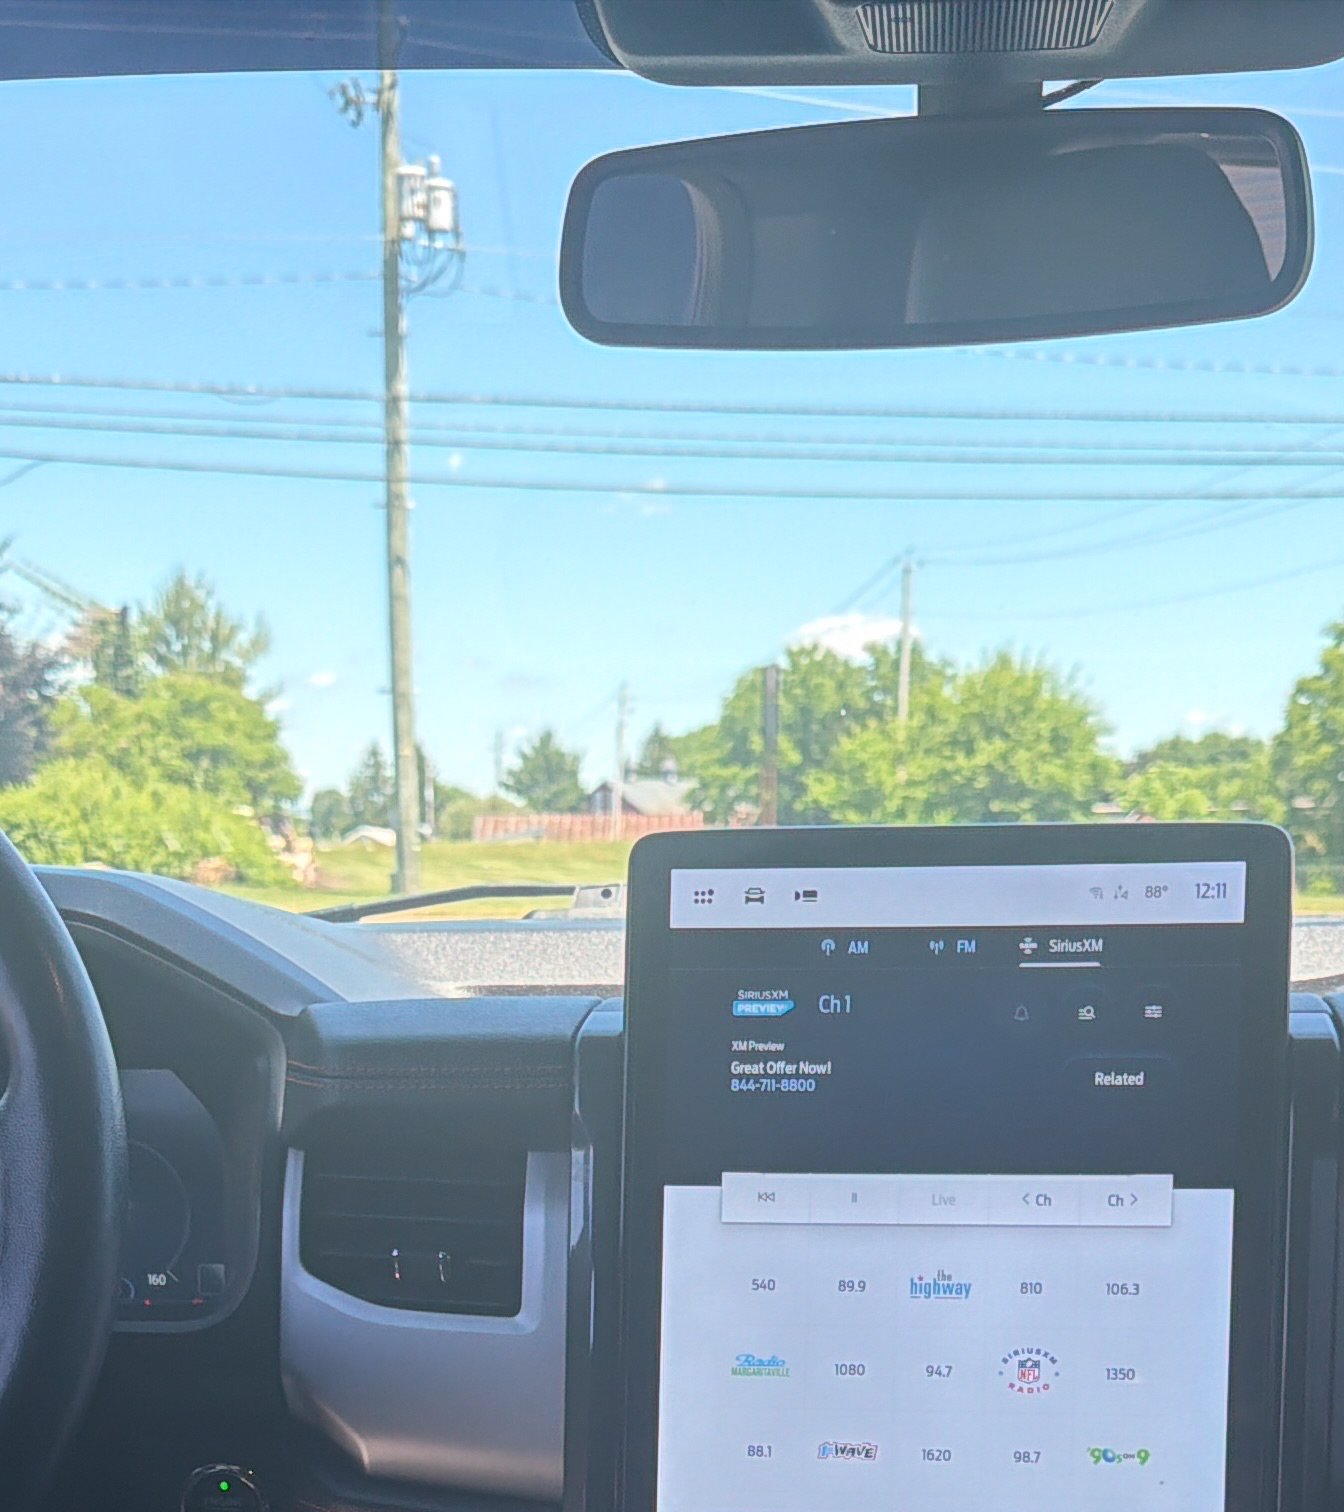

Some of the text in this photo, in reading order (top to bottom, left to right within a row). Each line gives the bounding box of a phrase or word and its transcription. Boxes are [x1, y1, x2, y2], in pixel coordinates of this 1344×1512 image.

[1144, 885, 1168, 899] 88°
[1195, 882, 1227, 899] 12:11
[848, 940, 869, 954] AM
[957, 939, 976, 953] FM
[1049, 938, 1103, 953] SiriusXM
[737, 989, 789, 1000] SIRIUSXM
[818, 994, 851, 1014] Ch 1
[731, 1040, 785, 1052] XM Preview
[730, 1061, 832, 1075] Great Offer Now!
[730, 1078, 816, 1092] 844-711-8800
[1094, 1071, 1145, 1086] Related
[931, 1192, 956, 1207] Live
[1035, 1193, 1052, 1208] Ch
[1107, 1193, 1124, 1208] Ch
[147, 1273, 167, 1286] 160
[937, 1269, 953, 1281] the
[750, 1278, 776, 1294] 540
[837, 1279, 867, 1294] 89.9
[910, 1276, 972, 1299] highway
[1019, 1282, 1043, 1295] 810
[1105, 1283, 1140, 1296] 106.3
[834, 1363, 866, 1376] 1080
[925, 1365, 953, 1379] 94.7
[1020, 1369, 1040, 1381] NFL
[1105, 1368, 1136, 1382] 1350
[1008, 1382, 1050, 1393] RADIO
[747, 1445, 772, 1457] 88.1
[921, 1448, 951, 1462] 1620
[1013, 1450, 1041, 1464] 98.7
[1136, 1448, 1151, 1465] 9
